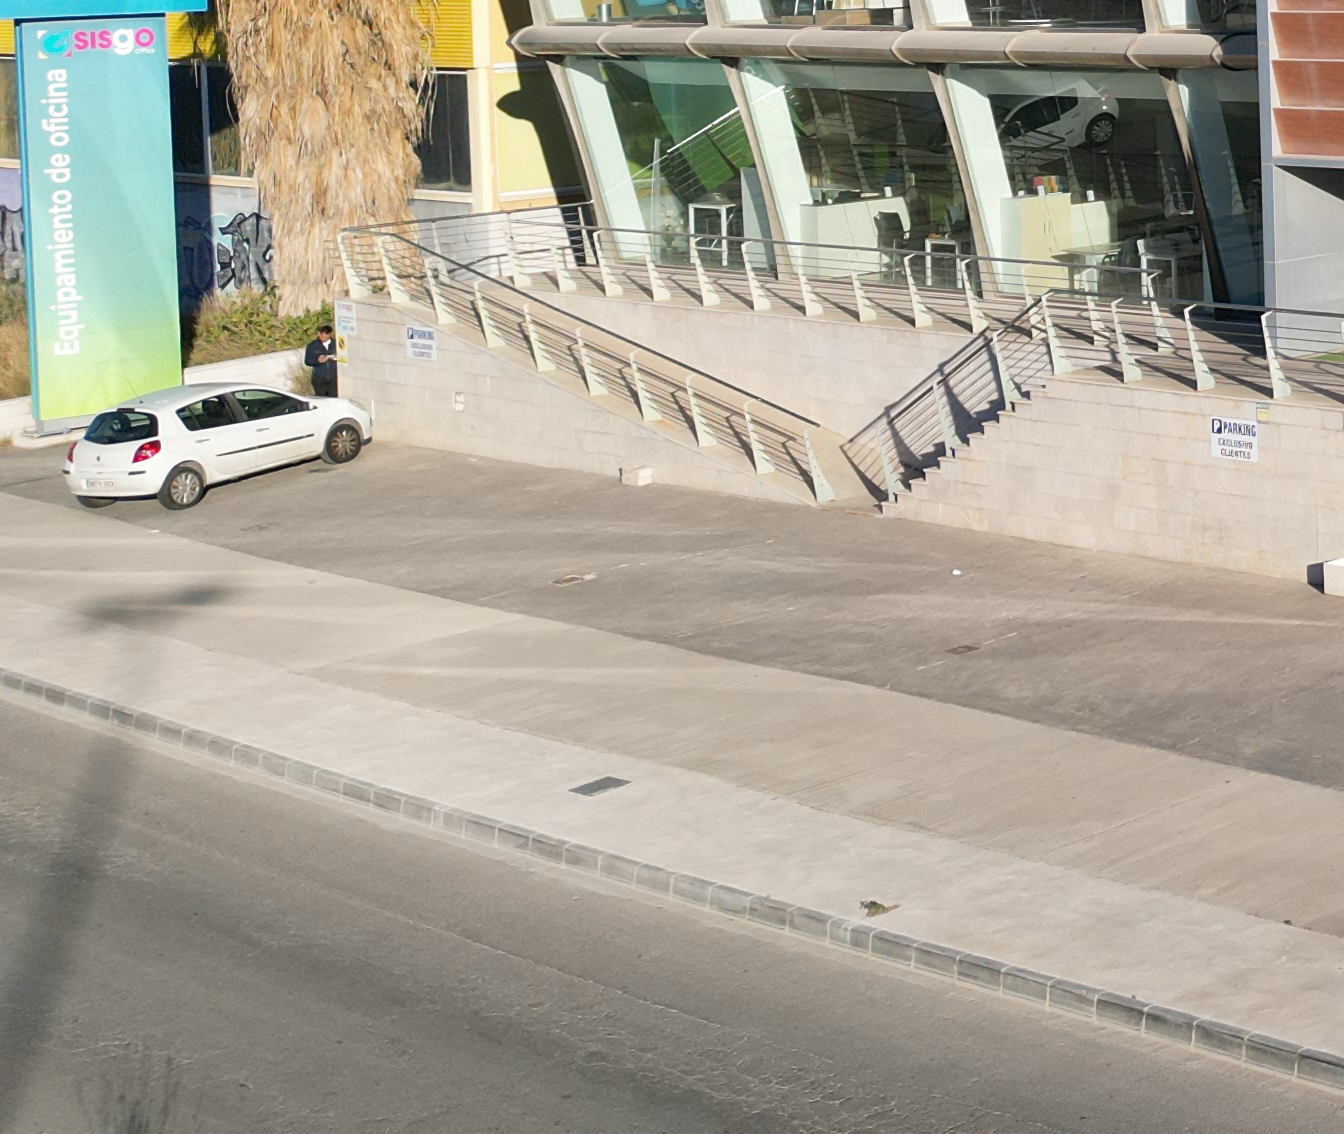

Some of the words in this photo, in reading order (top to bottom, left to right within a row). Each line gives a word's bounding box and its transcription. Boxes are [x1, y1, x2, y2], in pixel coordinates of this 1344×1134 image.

[73, 28, 155, 55] sisgo
[40, 68, 70, 147] oficina
[44, 153, 71, 183] de
[48, 189, 85, 356] Equipamiento
[1223, 421, 1256, 437] PARKING
